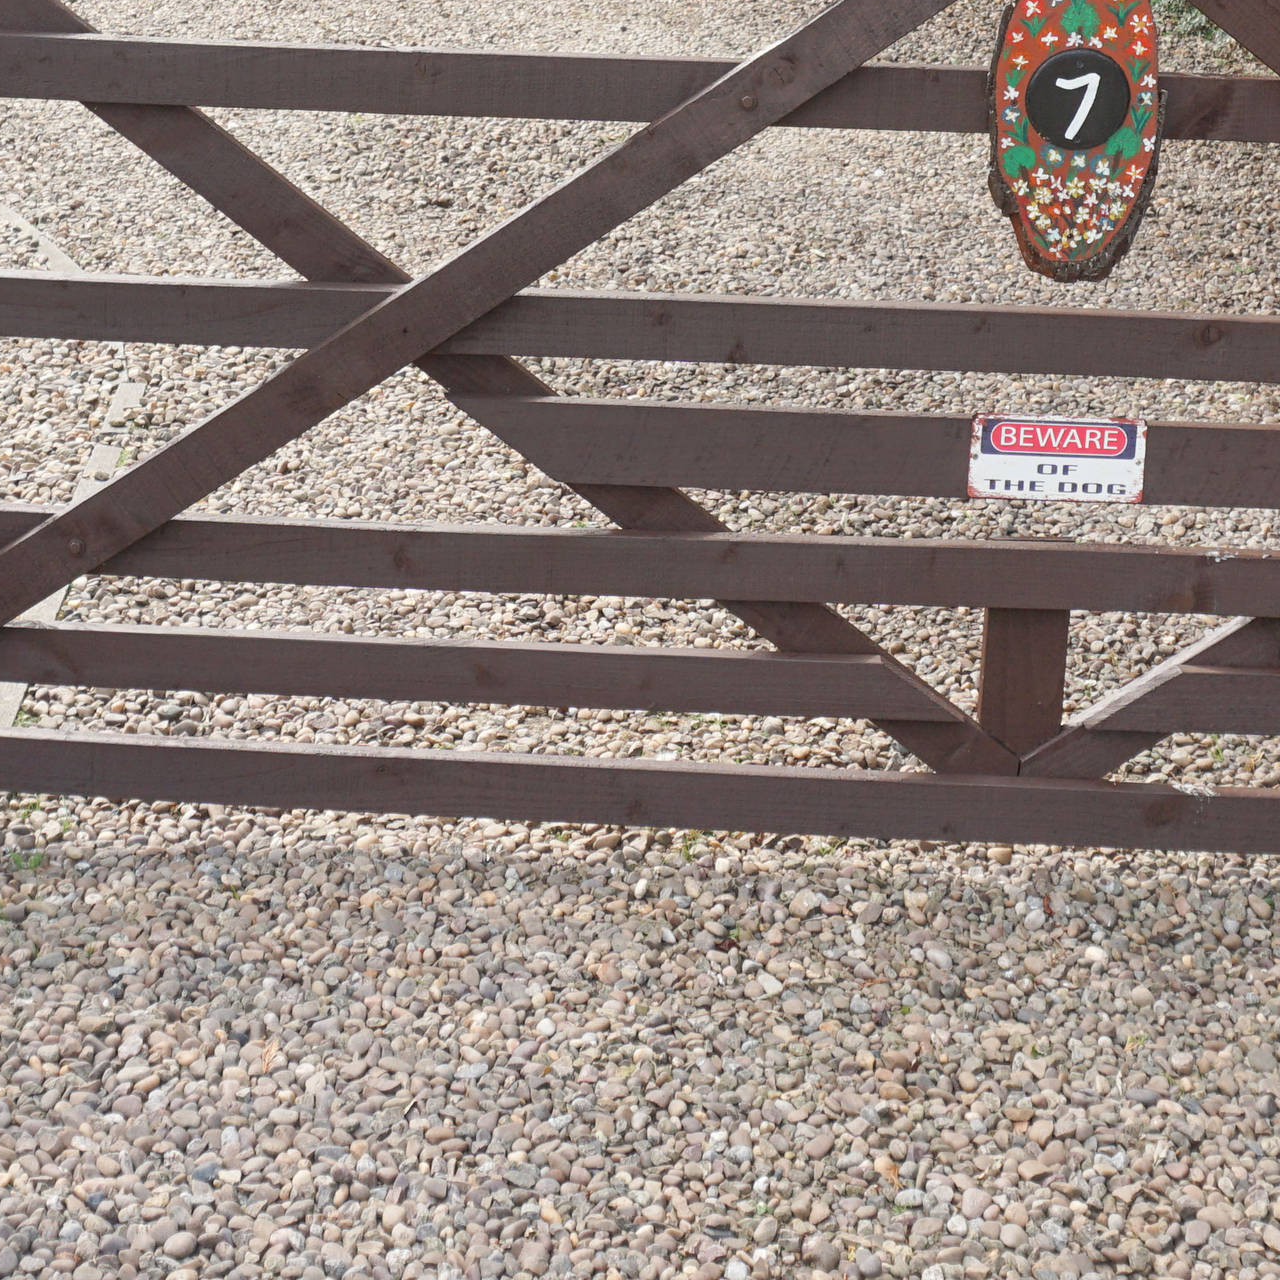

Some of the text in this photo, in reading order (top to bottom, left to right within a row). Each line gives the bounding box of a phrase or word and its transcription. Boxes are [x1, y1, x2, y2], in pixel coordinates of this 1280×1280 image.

[1055, 72, 1100, 140] 7
[1000, 426, 1118, 450] BEWARE
[1037, 463, 1078, 475] OF
[983, 478, 1127, 495] THE DOG
